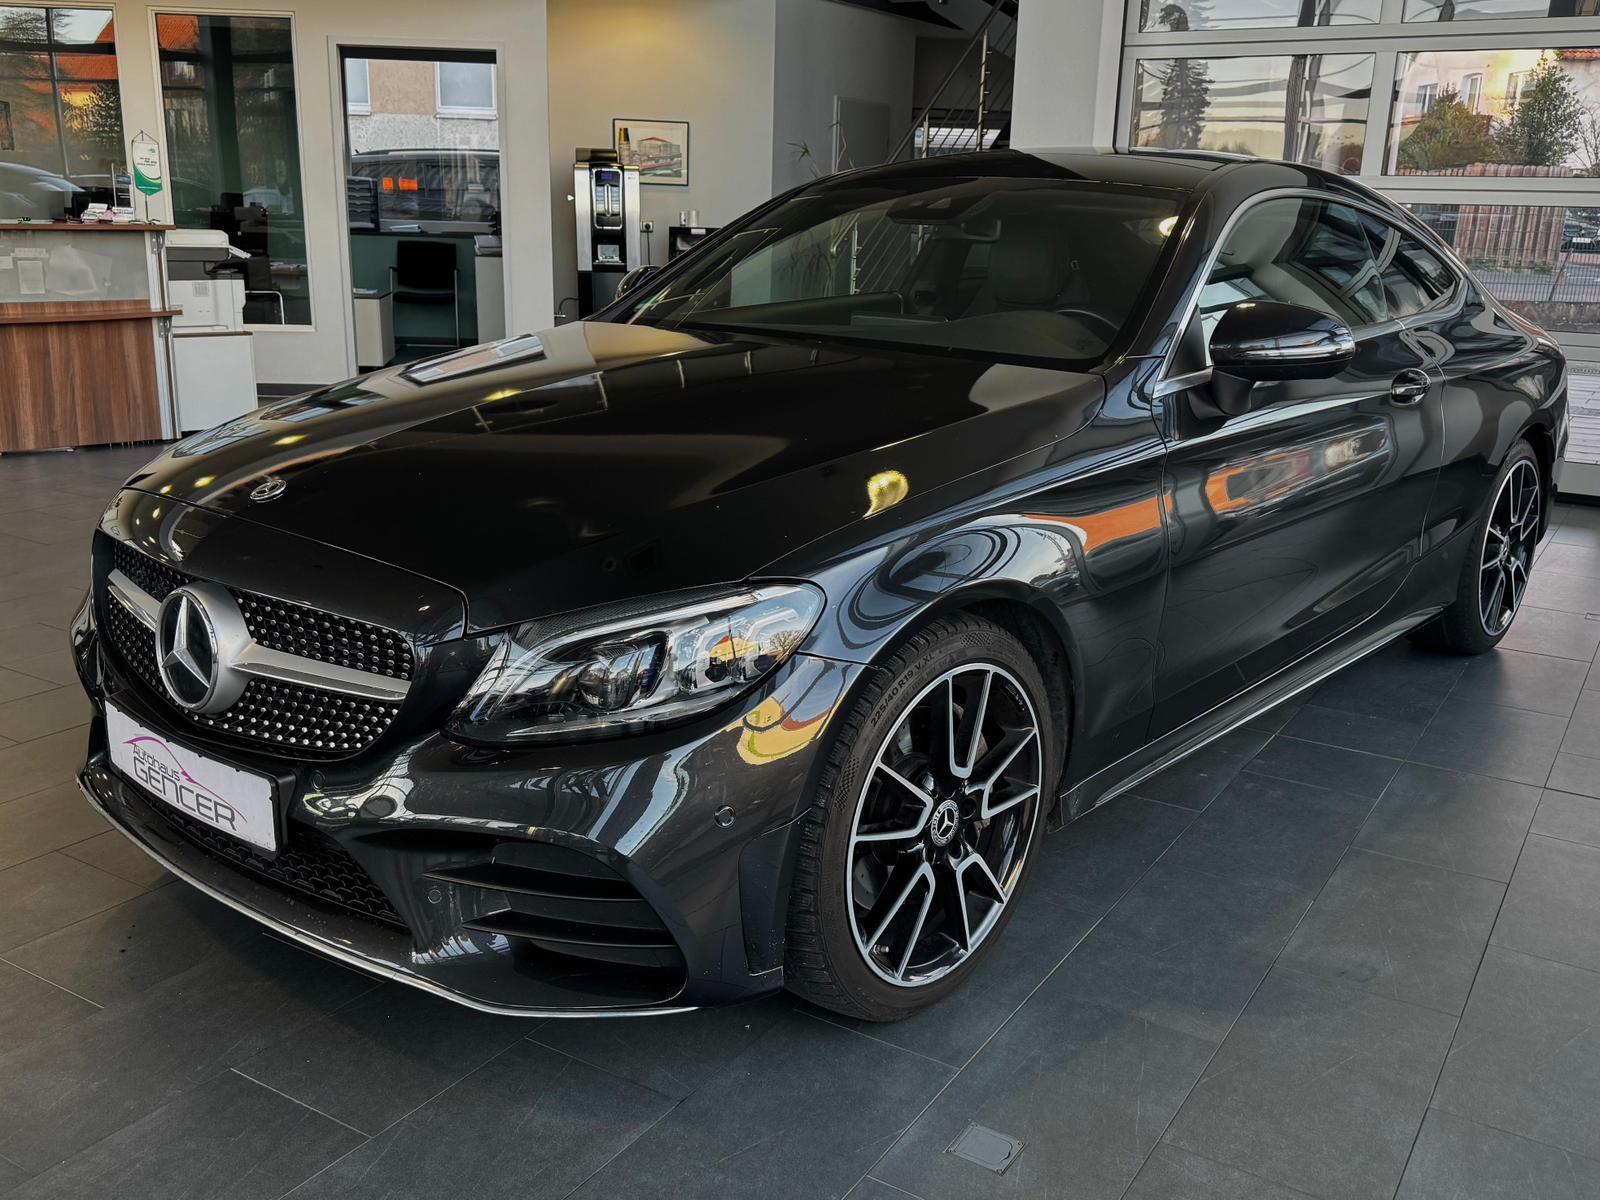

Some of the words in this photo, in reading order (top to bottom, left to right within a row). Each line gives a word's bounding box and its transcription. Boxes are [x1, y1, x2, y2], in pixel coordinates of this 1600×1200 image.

[871, 688, 899, 727] 225/40
[898, 670, 914, 688] R19
[923, 654, 934, 665] XL
[133, 744, 180, 781] Autohaus
[133, 756, 236, 830] GENCER
